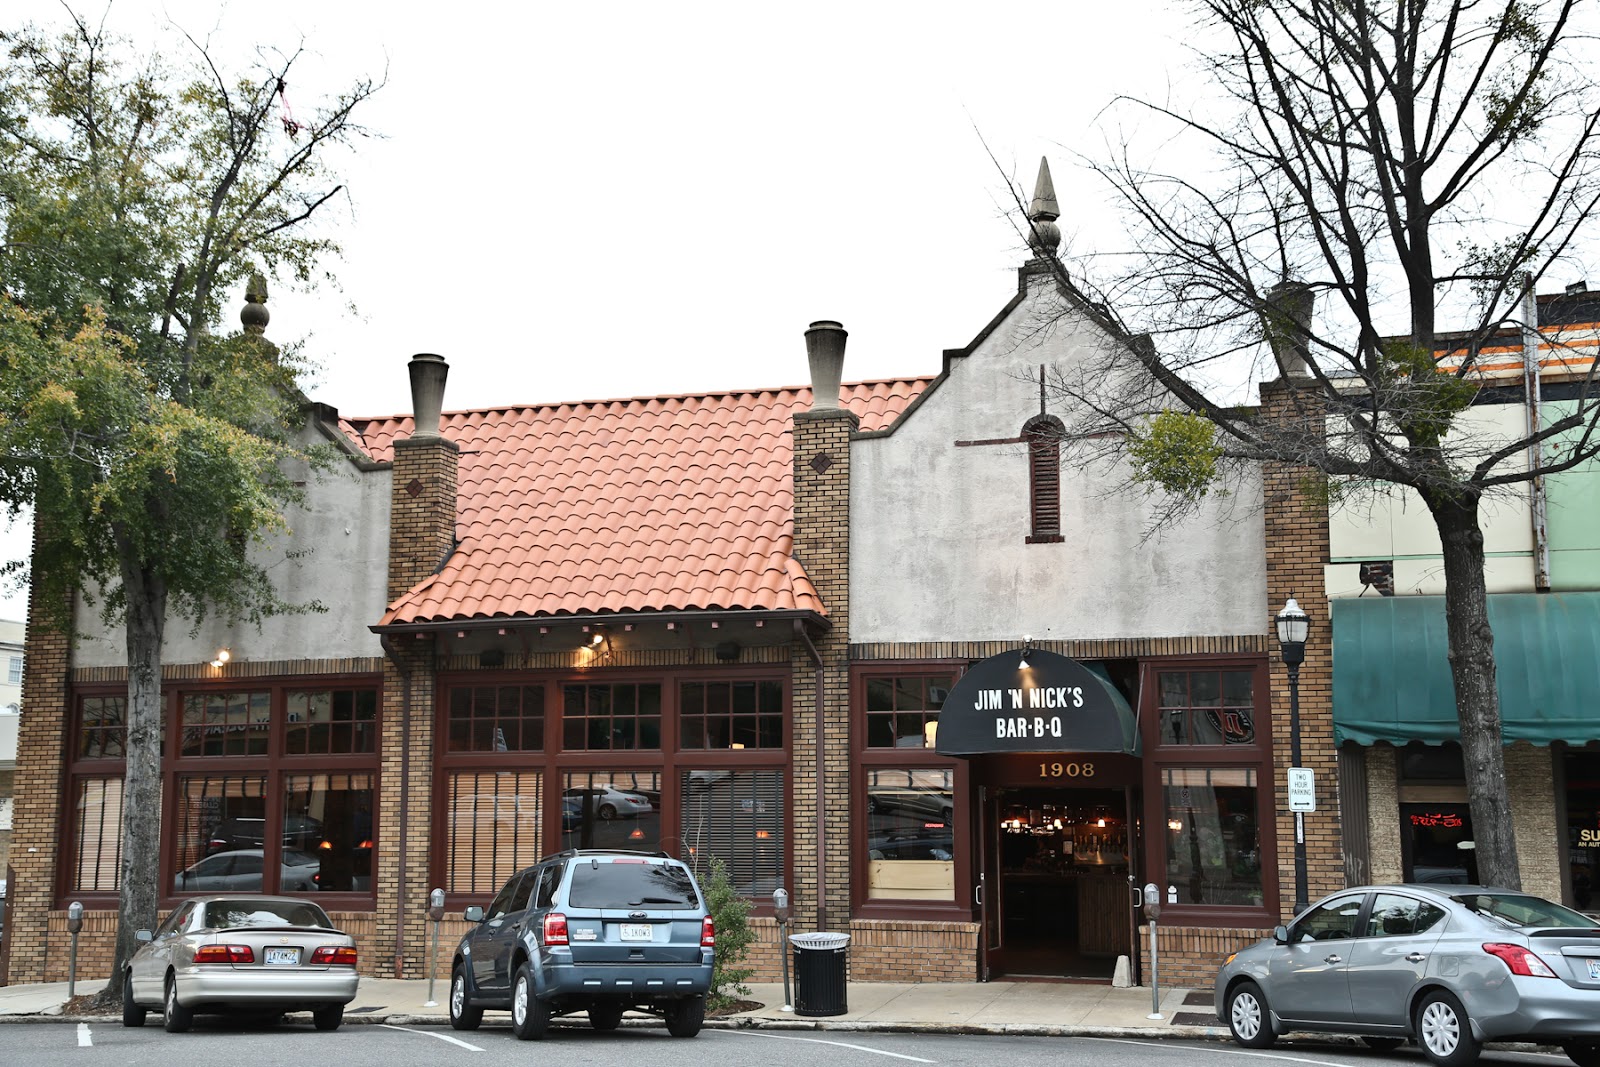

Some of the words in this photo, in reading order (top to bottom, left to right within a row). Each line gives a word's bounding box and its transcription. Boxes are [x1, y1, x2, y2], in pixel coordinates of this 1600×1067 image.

[974, 689, 1003, 711] JIM
[1007, 688, 1023, 709] 'N
[1029, 686, 1084, 709] NICK'S
[1039, 762, 1095, 777] 1908
[1295, 773, 1307, 781] TWO
[1291, 788, 1311, 796] PARKING
